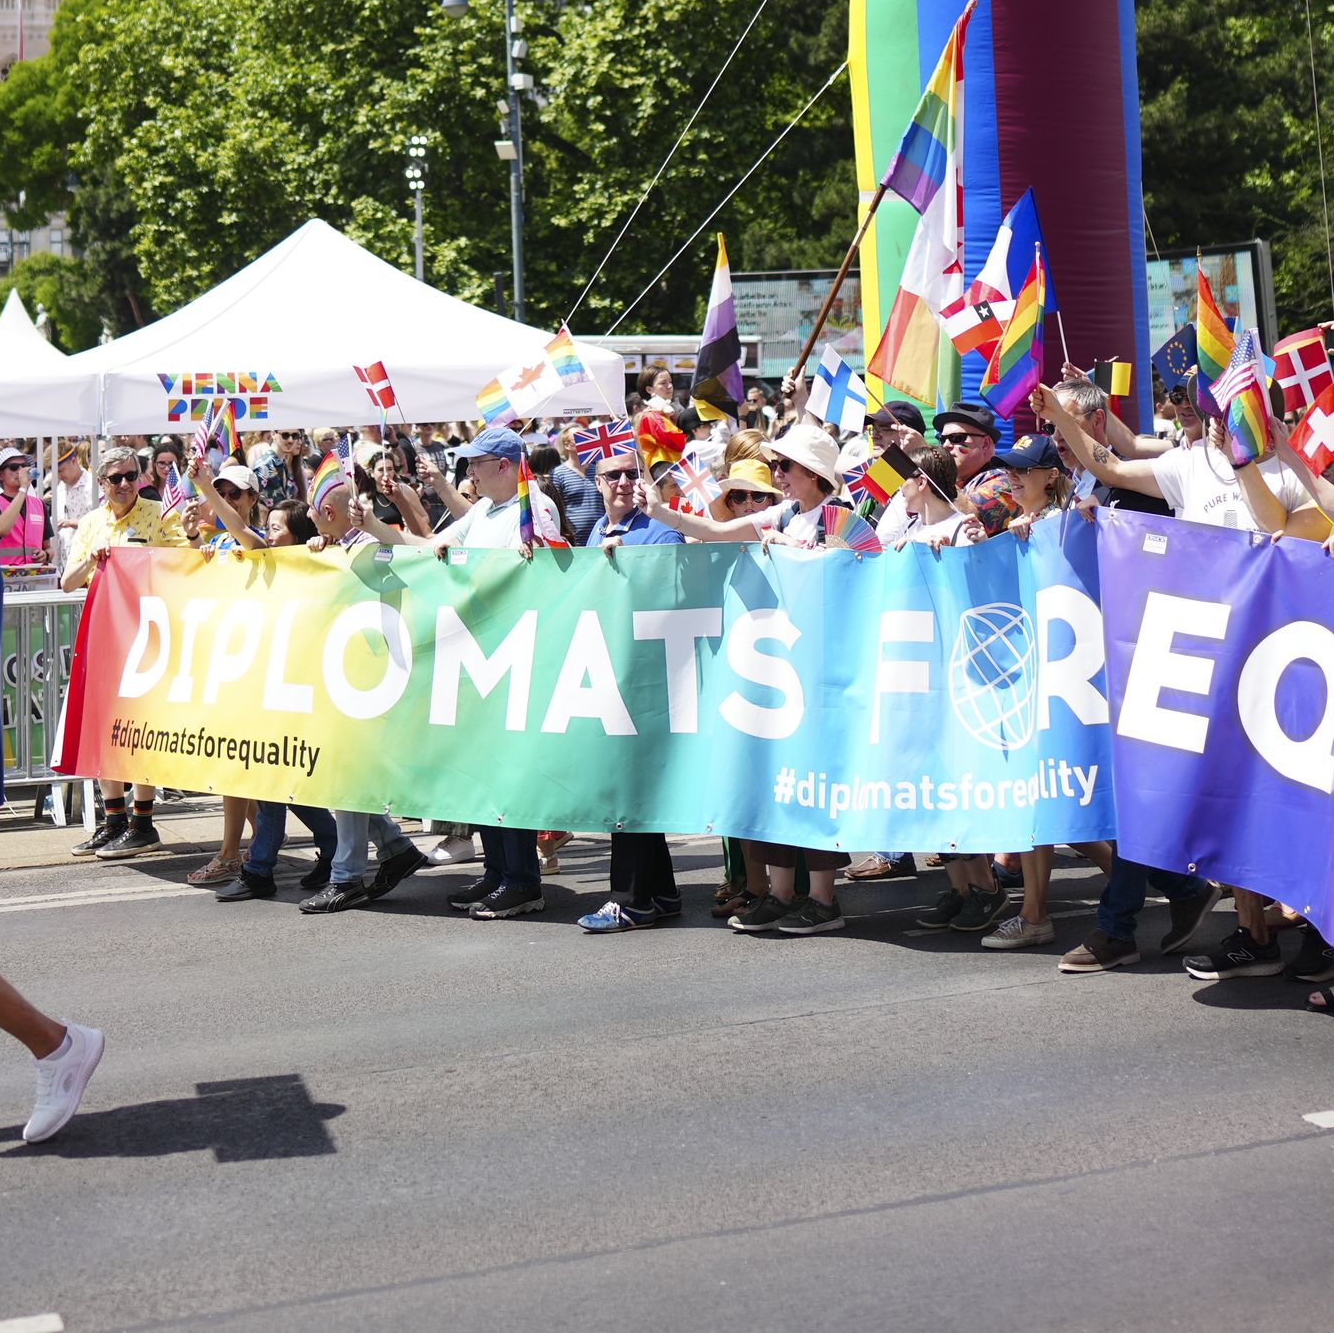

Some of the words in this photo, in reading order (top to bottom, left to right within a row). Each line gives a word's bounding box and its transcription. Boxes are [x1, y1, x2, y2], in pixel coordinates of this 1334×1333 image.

[157, 372, 283, 395] VIENNA
[1203, 493, 1228, 513] PURE
[117, 595, 805, 740] DIPLOMATS
[111, 719, 321, 777] #diplomatsforequality
